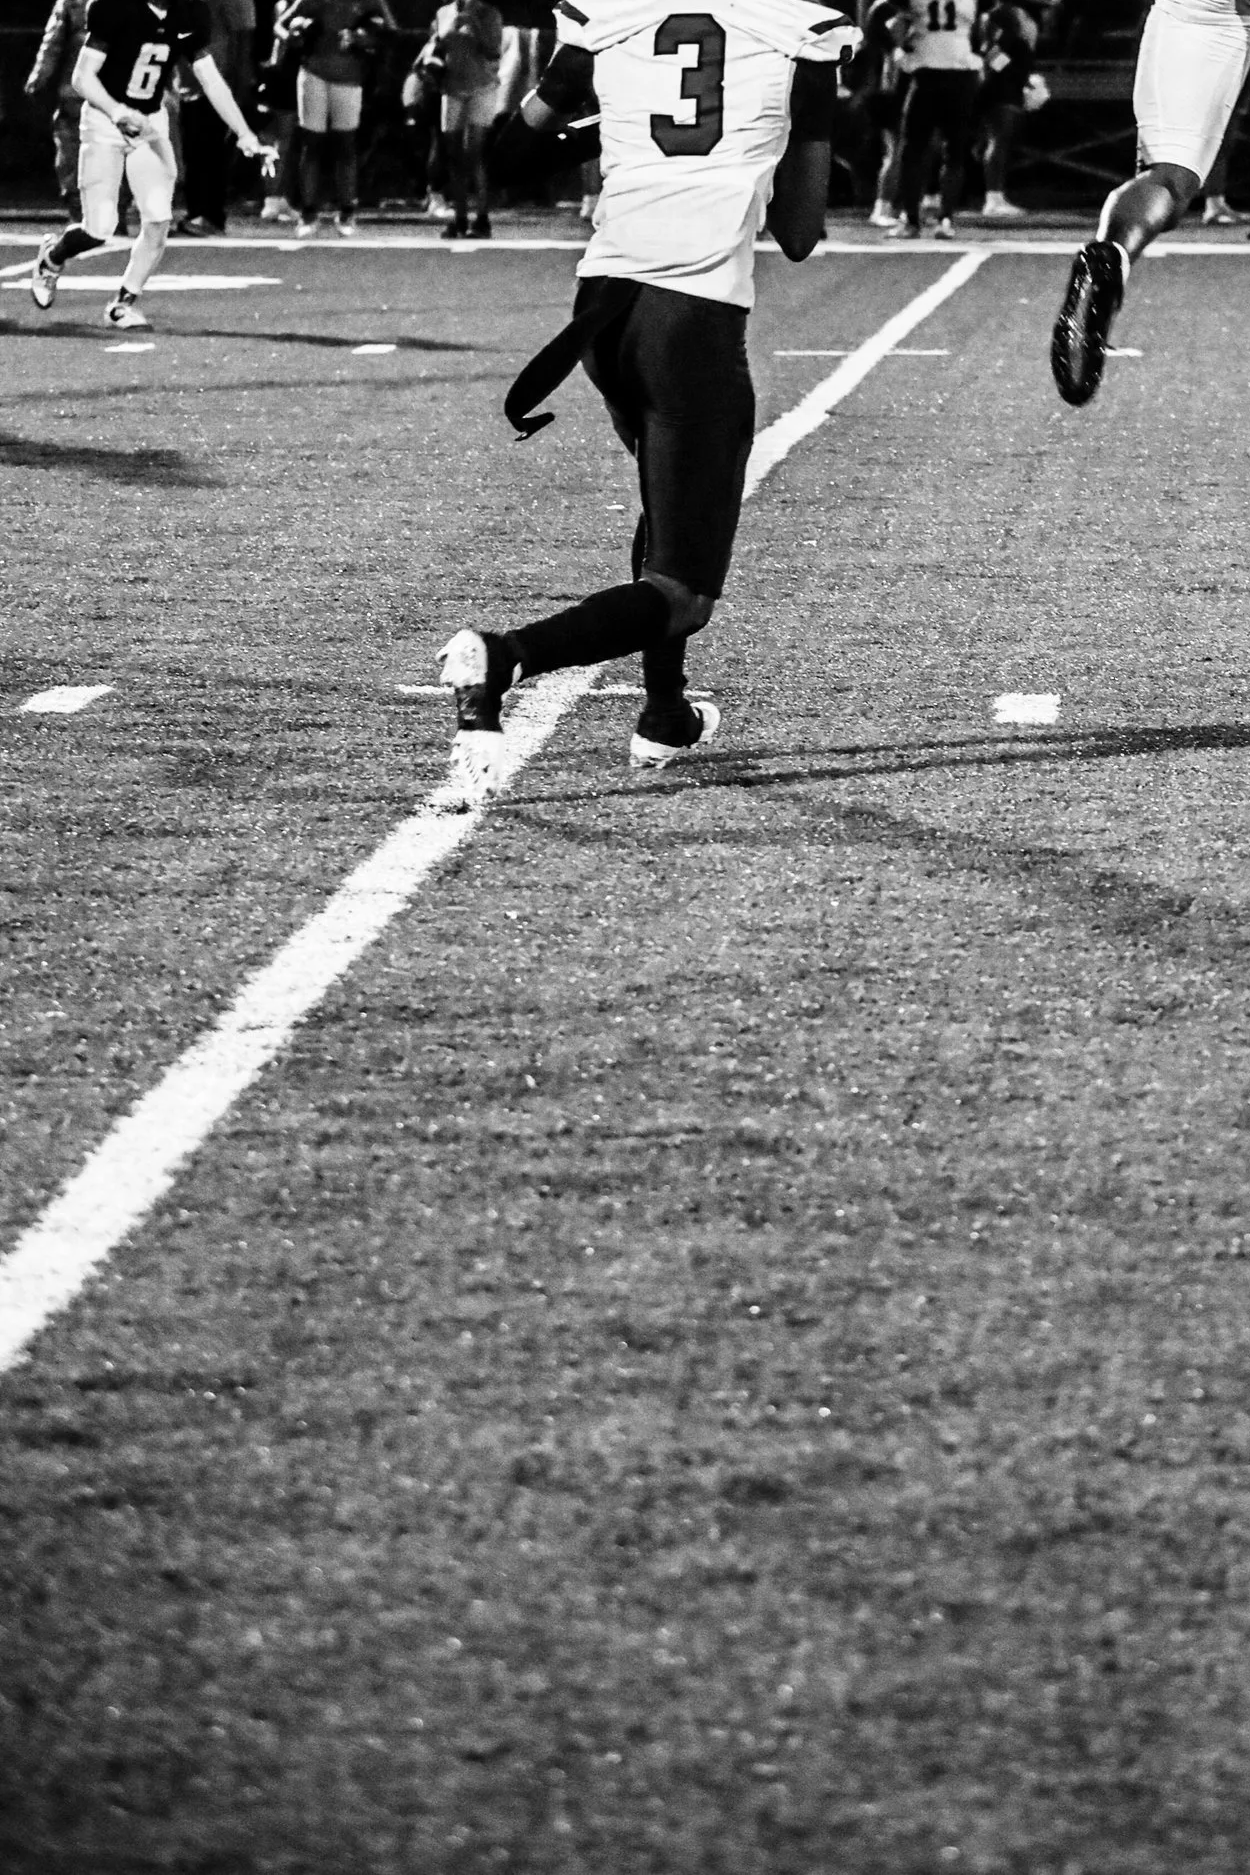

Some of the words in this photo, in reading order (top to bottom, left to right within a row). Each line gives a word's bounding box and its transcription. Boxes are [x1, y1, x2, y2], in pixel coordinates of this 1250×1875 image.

[927, 0, 956, 31] 11
[125, 42, 171, 100] 6
[650, 13, 726, 157] 3
